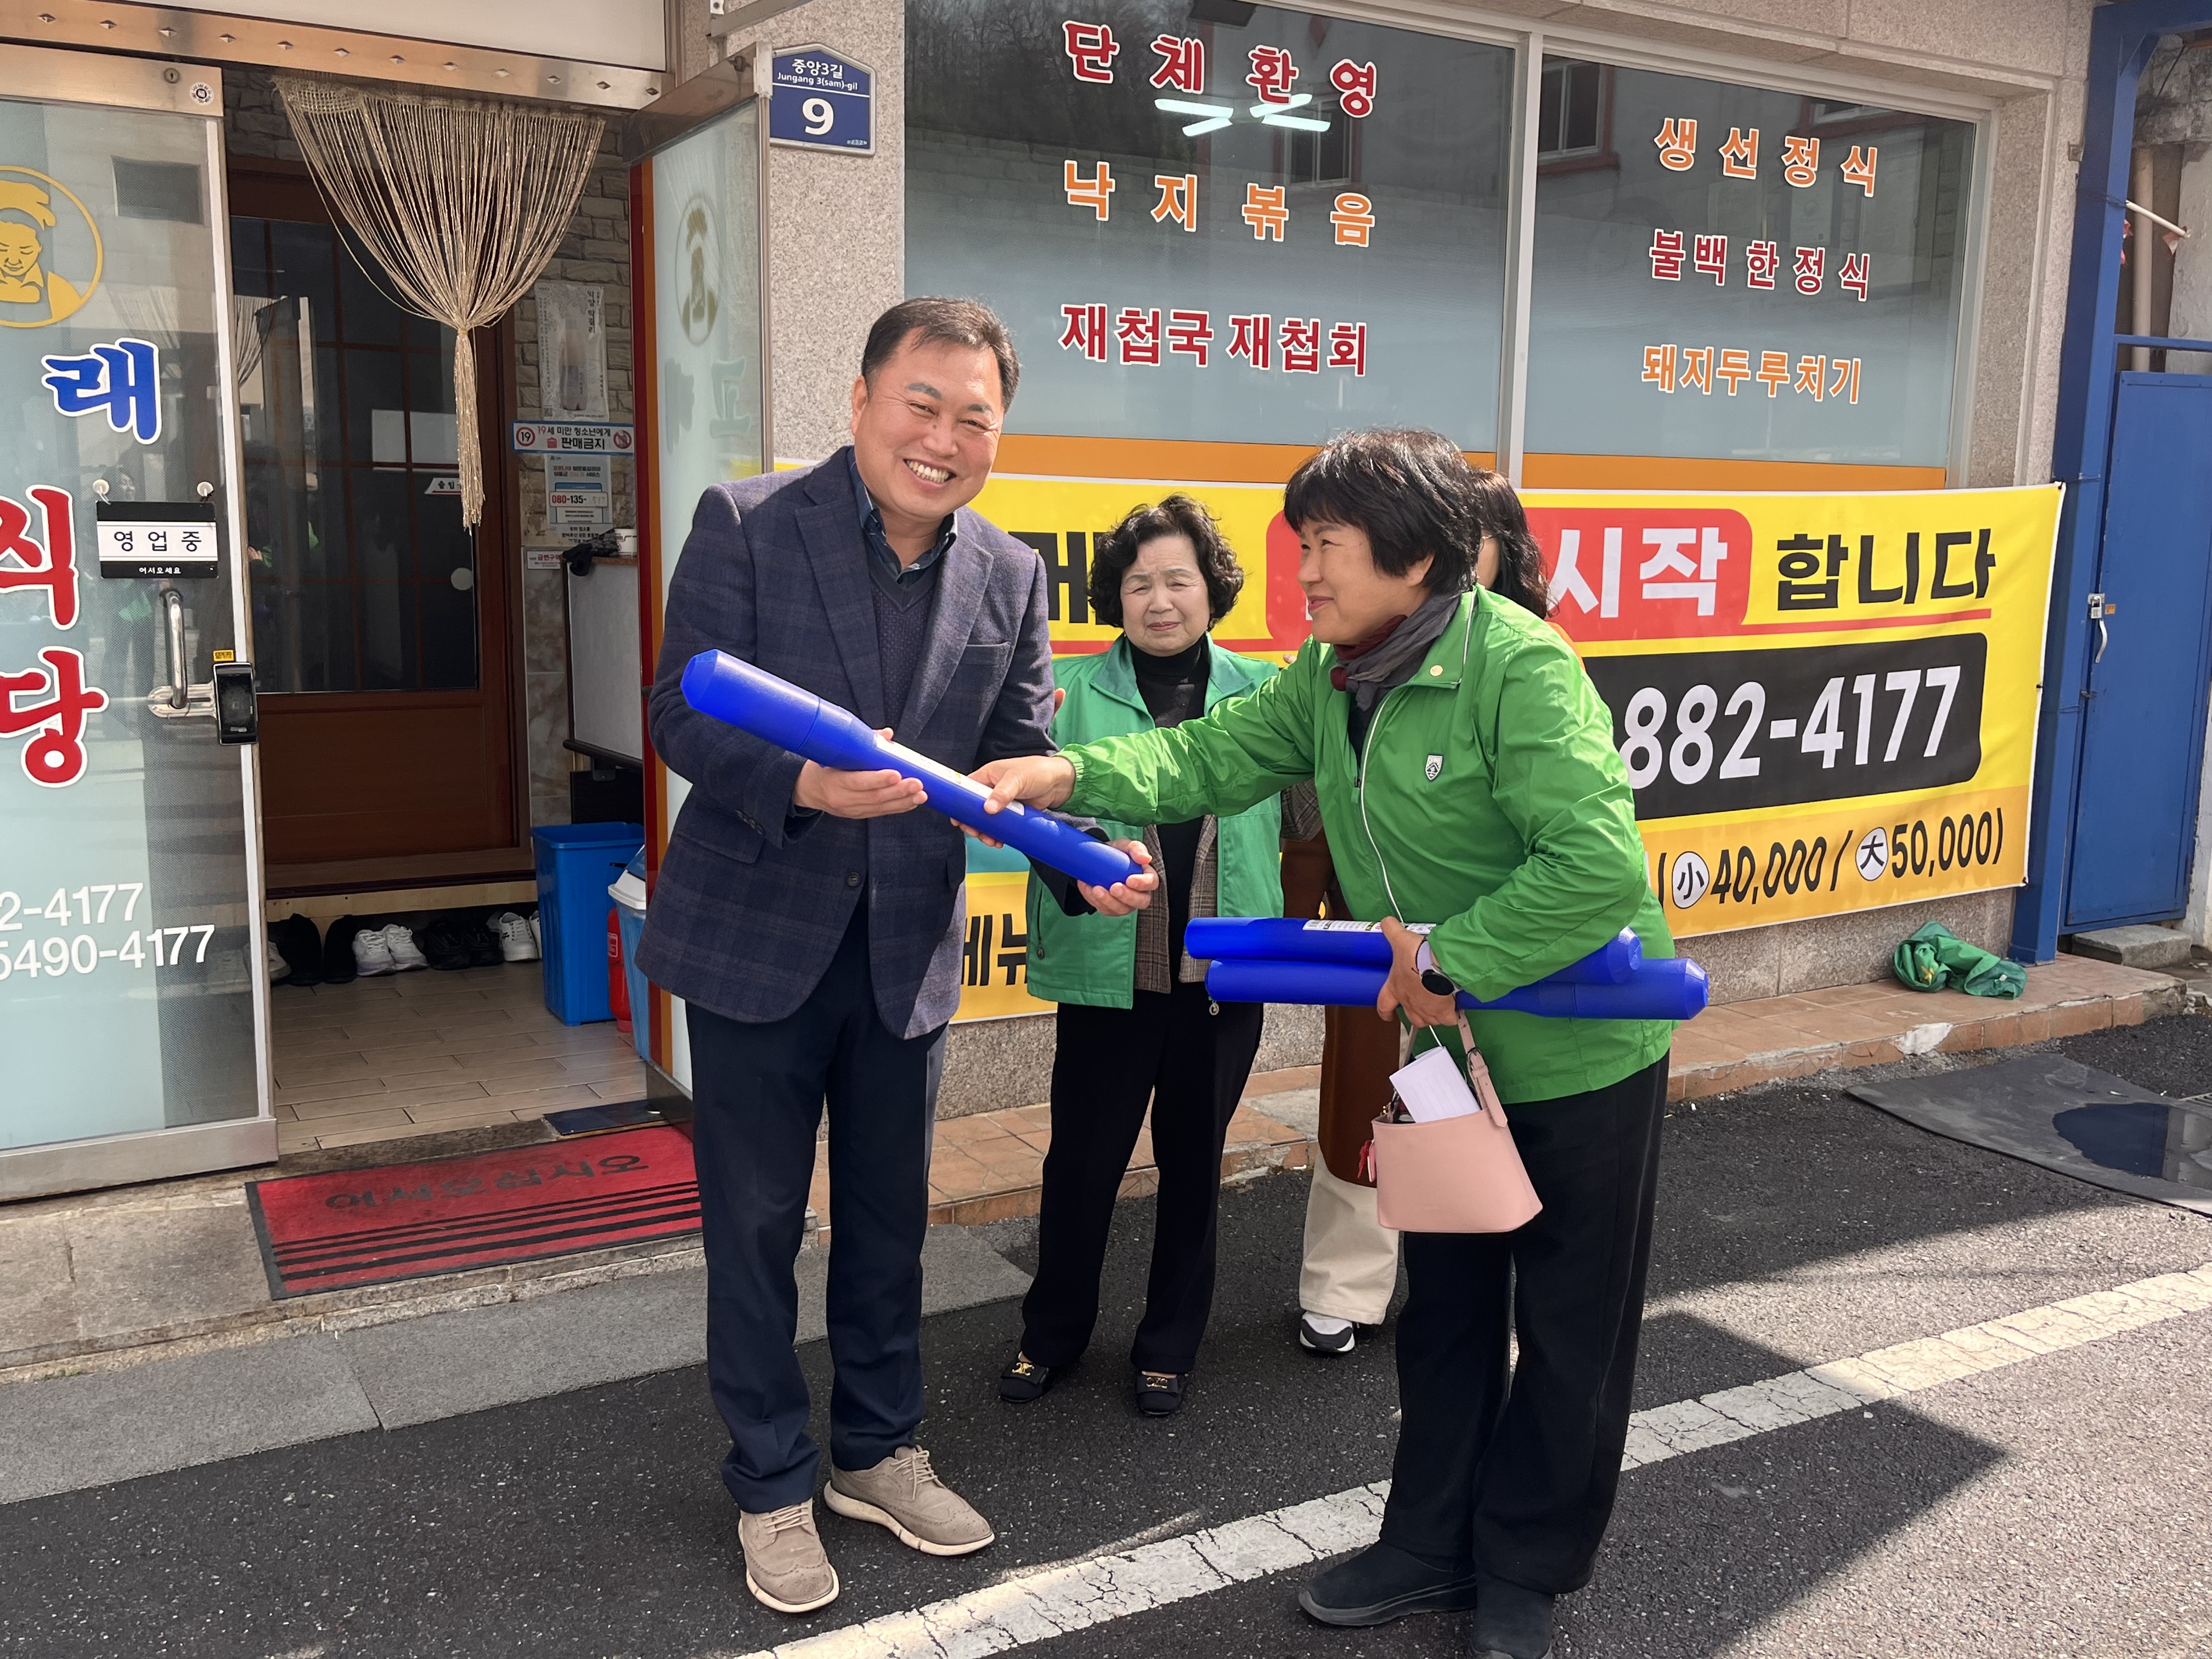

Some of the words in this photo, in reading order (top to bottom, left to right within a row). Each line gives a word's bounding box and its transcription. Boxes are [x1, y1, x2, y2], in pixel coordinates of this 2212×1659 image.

[792, 59, 843, 79] 중앙3길
[777, 72, 814, 85] Jungang
[816, 77, 858, 91] 3(sam)-gil
[802, 98, 834, 135] 9
[1058, 303, 1214, 367] 재첩국
[1226, 314, 1367, 376] 재첩회
[1642, 344, 1861, 404] 돼지두루치기
[521, 431, 531, 442] 19
[557, 426, 572, 436] 미만
[574, 427, 611, 437] 청소년에게
[561, 437, 605, 450] 판매금지
[138, 567, 181, 575] 어서오세요
[1546, 527, 1728, 618] 시작
[1776, 528, 1996, 611] 합니다
